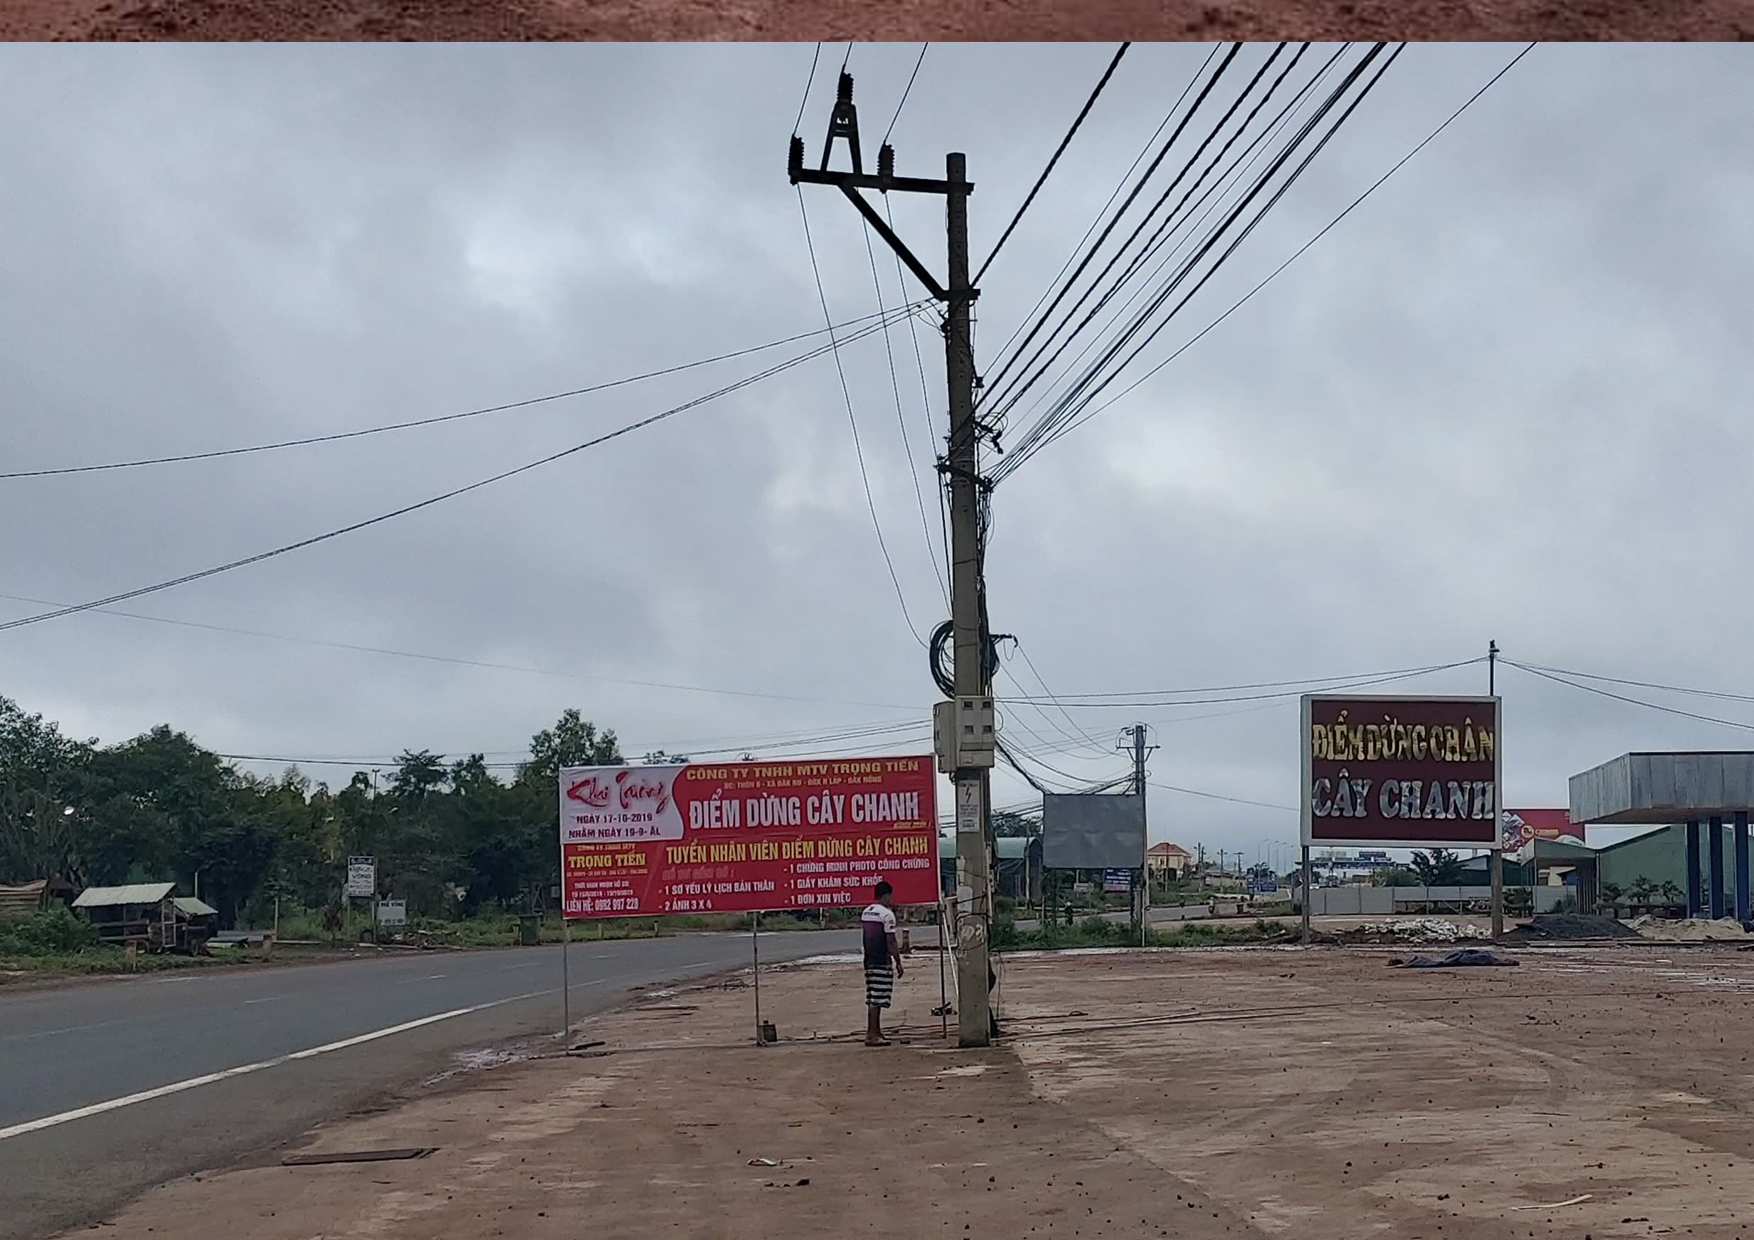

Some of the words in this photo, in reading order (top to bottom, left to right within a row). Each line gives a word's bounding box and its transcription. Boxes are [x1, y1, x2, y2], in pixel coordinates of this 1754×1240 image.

[686, 767, 728, 780] CÔNG
[732, 767, 749, 779] TY
[754, 766, 793, 778] TNHH
[797, 764, 828, 776] MTV
[832, 762, 882, 776] TRỌNG
[1312, 768, 1373, 818] CÂY
[1379, 779, 1495, 820] CHANH
[689, 788, 740, 829] ĐIỂM
[747, 791, 801, 827] DỪNG
[806, 789, 845, 825] CÂY
[851, 791, 919, 823] CHANH
[856, 835, 881, 857] CÂY
[885, 836, 929, 856] CHANH
[568, 854, 613, 870] TRỌNG
